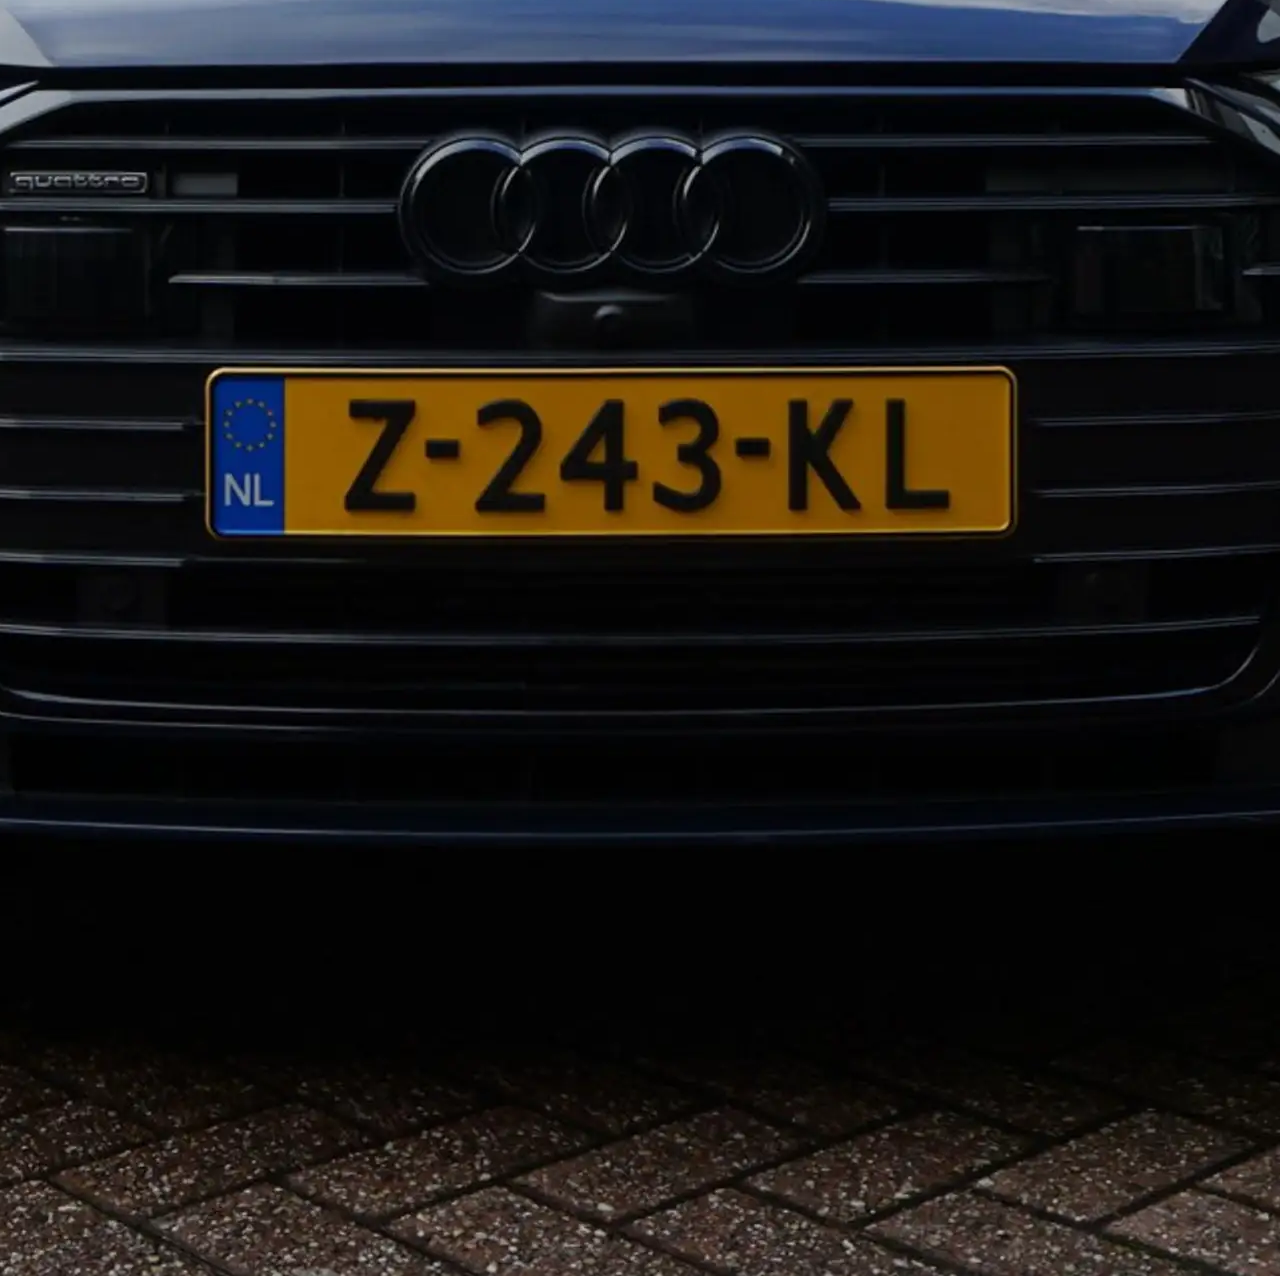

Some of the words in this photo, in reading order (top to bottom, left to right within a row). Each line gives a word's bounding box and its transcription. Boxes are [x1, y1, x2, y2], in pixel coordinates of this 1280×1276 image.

[15, 174, 140, 190] quattro
[344, 398, 951, 514] Z-243-KL
[223, 473, 275, 507] NL
